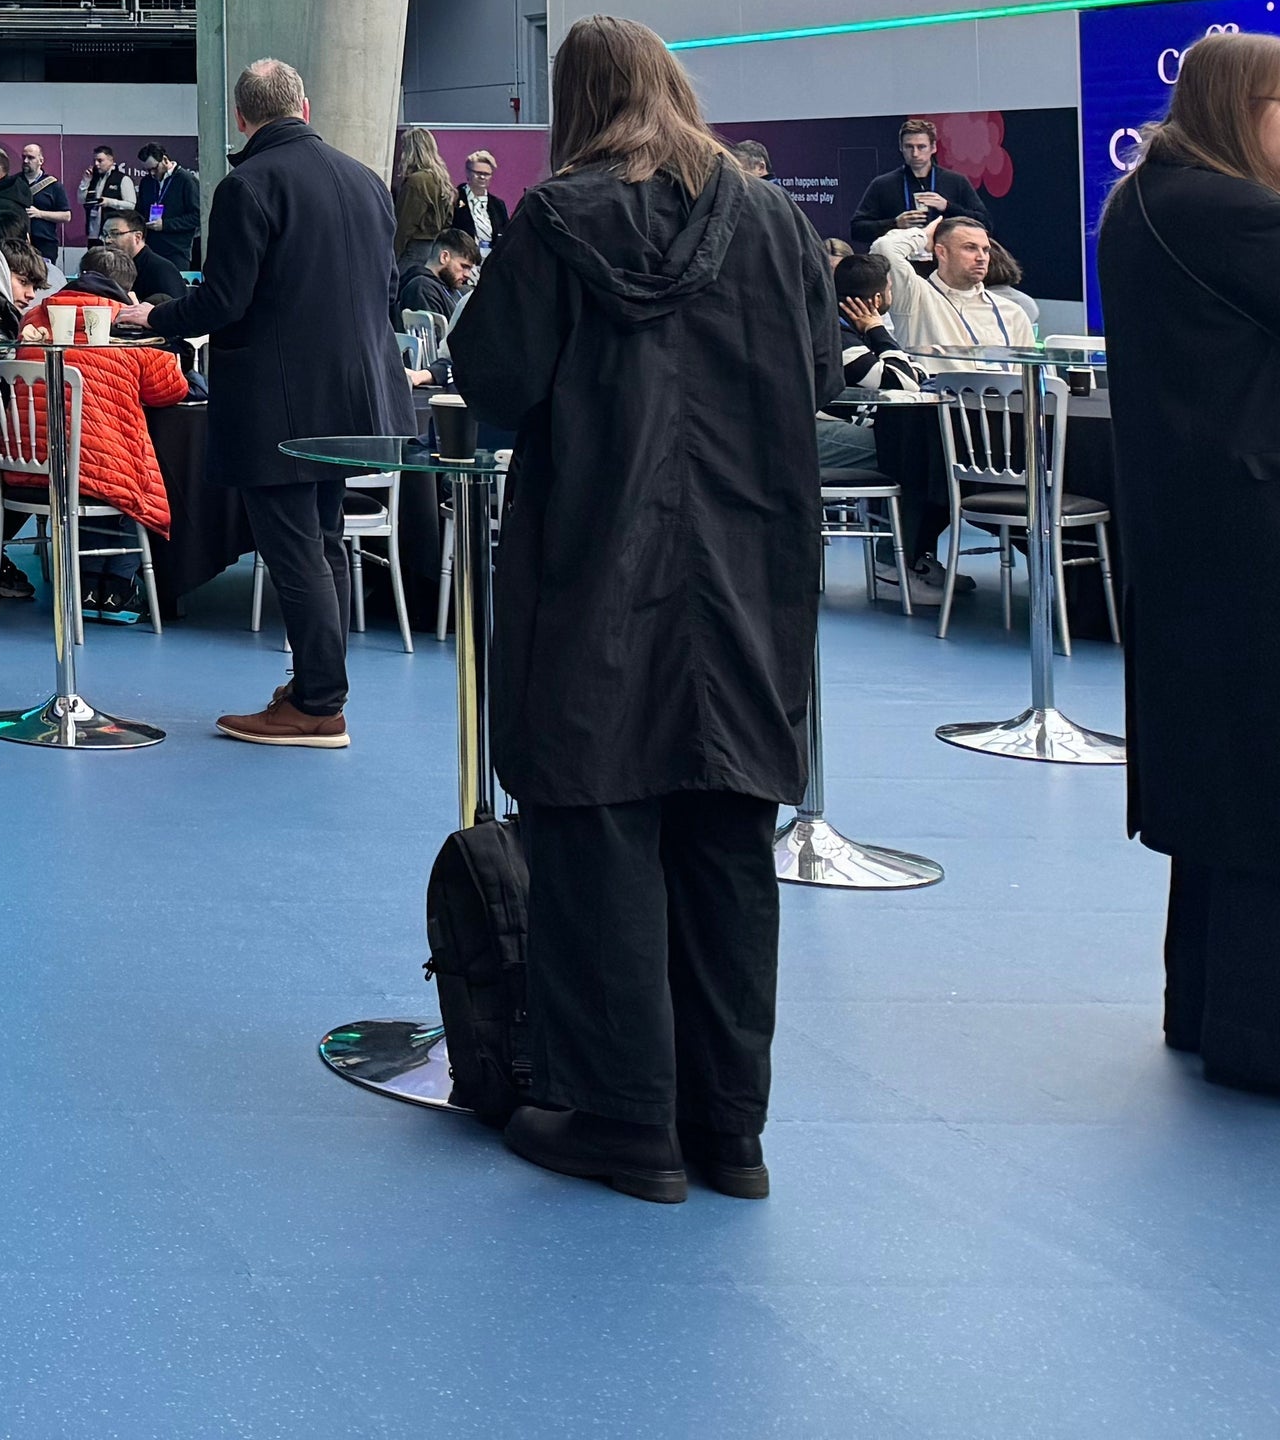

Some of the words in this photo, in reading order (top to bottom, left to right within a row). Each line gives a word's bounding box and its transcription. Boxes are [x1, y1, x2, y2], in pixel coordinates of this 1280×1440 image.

[782, 178, 794, 187] can
[795, 176, 819, 188] happen
[820, 176, 839, 187] when
[790, 191, 805, 202] deas
[806, 192, 818, 202] and
[820, 191, 834, 204] play
